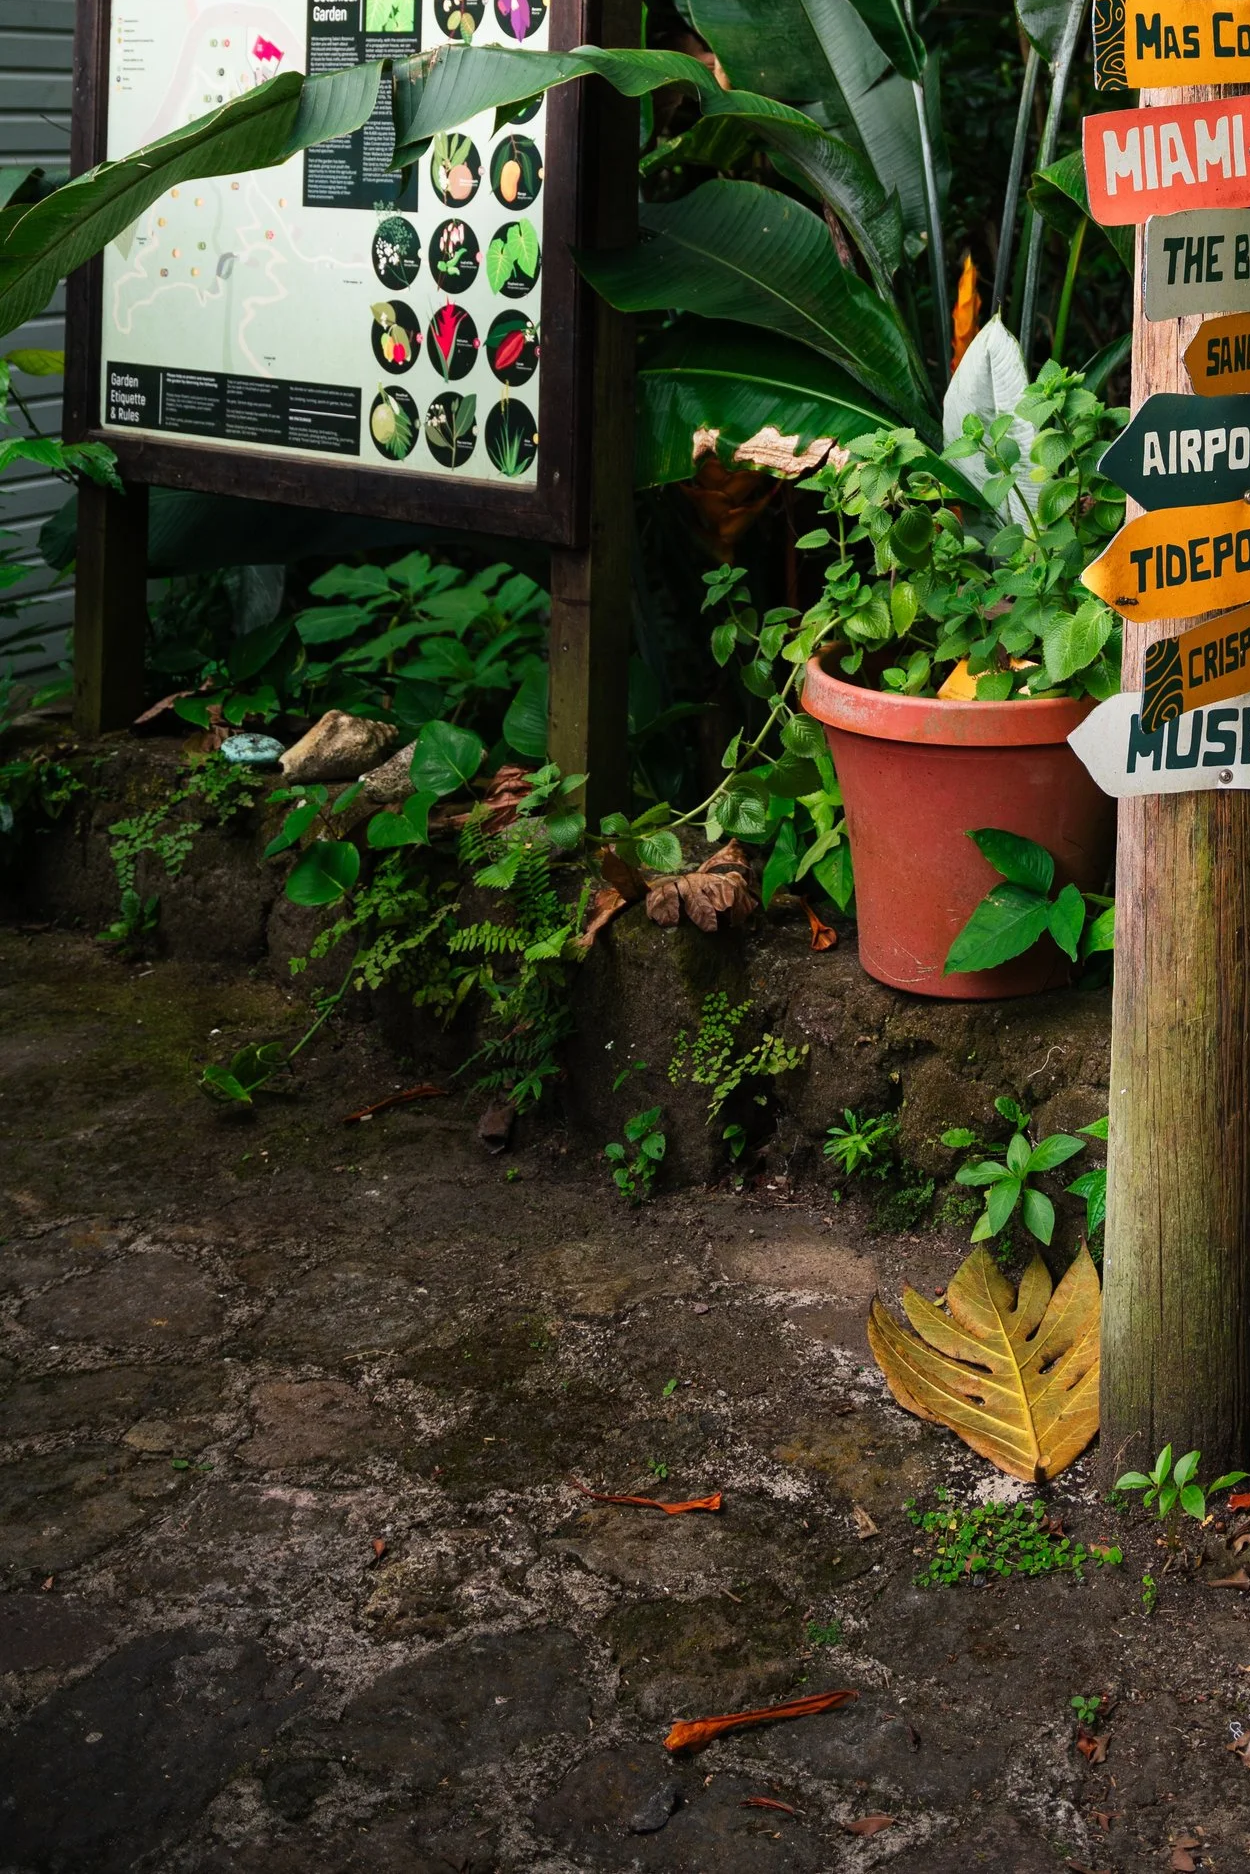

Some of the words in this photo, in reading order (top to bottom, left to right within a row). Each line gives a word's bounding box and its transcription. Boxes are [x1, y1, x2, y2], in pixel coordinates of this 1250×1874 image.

[313, 5, 348, 23] Garden
[1136, 12, 1200, 60] MAS
[1102, 113, 1248, 197] MIAMI
[1163, 237, 1226, 286] THE
[110, 372, 139, 388] Garden
[110, 389, 147, 407] Etiquette
[118, 407, 140, 423] Rules
